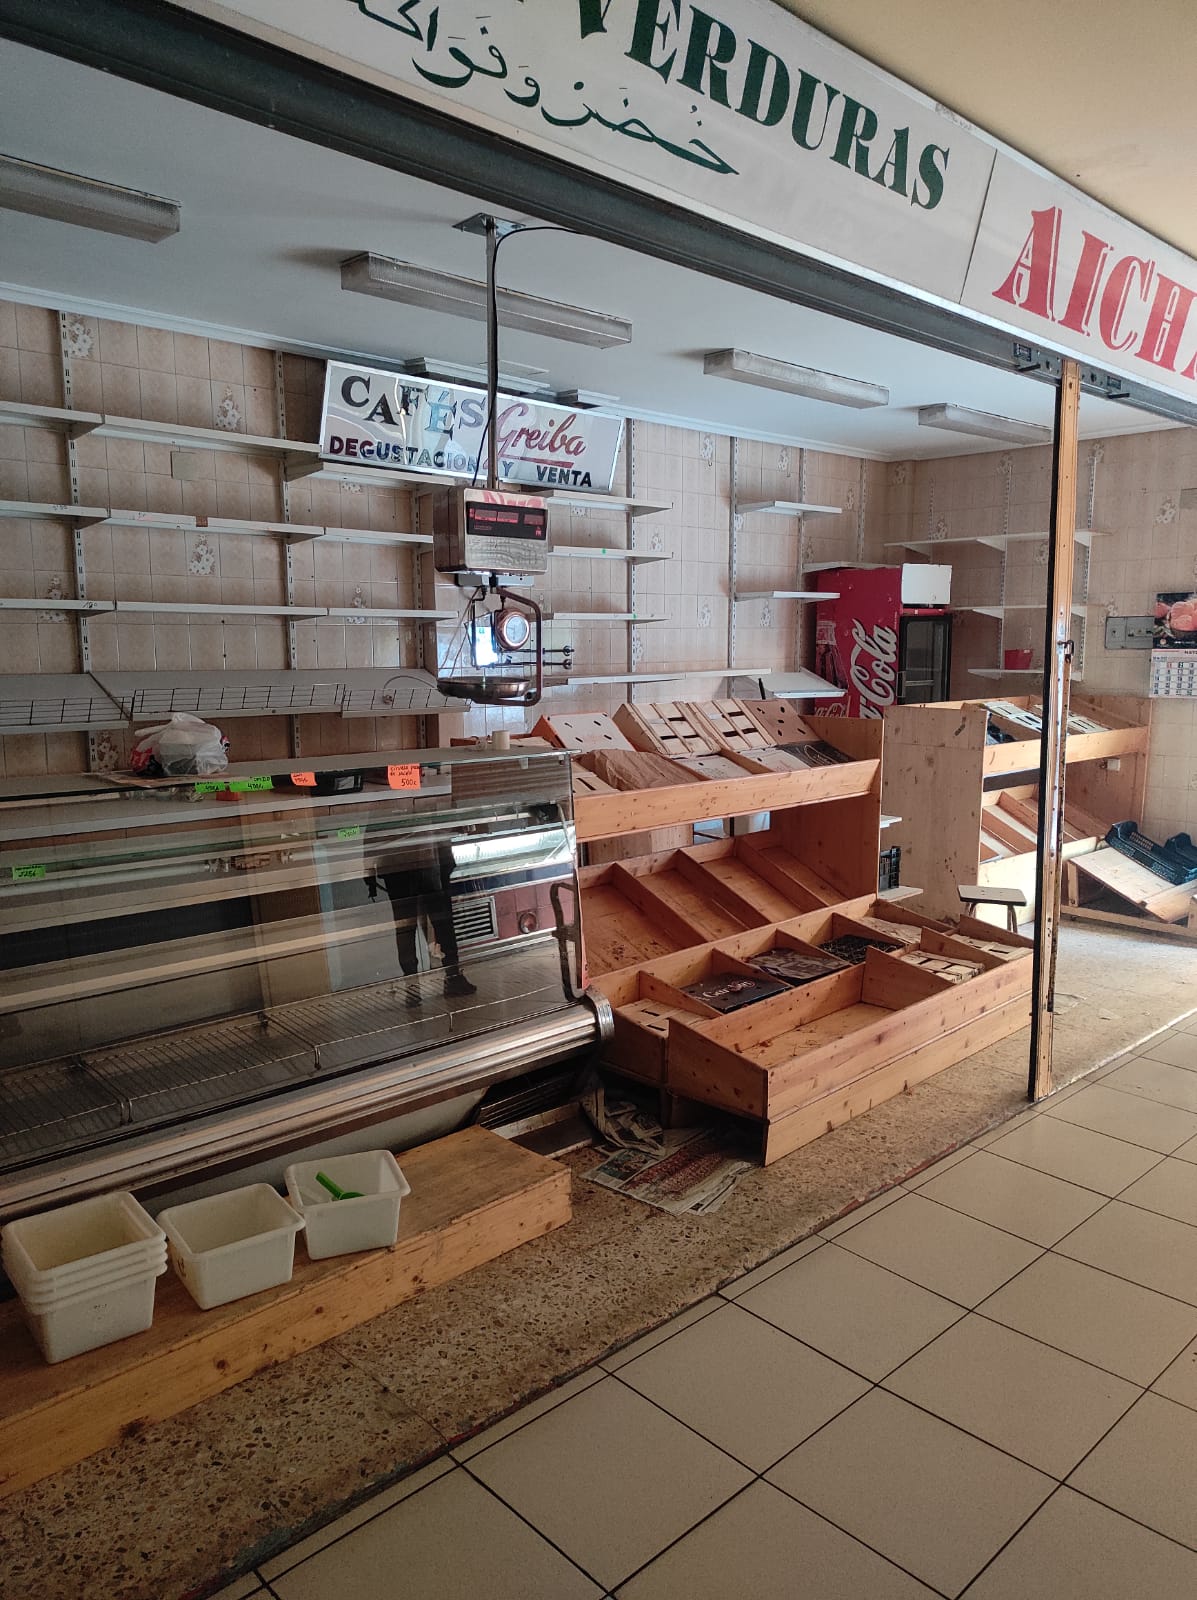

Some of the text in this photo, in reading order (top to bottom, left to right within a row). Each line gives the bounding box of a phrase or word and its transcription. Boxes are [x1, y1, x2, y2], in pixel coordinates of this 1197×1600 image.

[992, 206, 1197, 380] AICH
[341, 375, 487, 441] CAFÉS
[329, 435, 592, 488] DEGUSTACION Y VENTA
